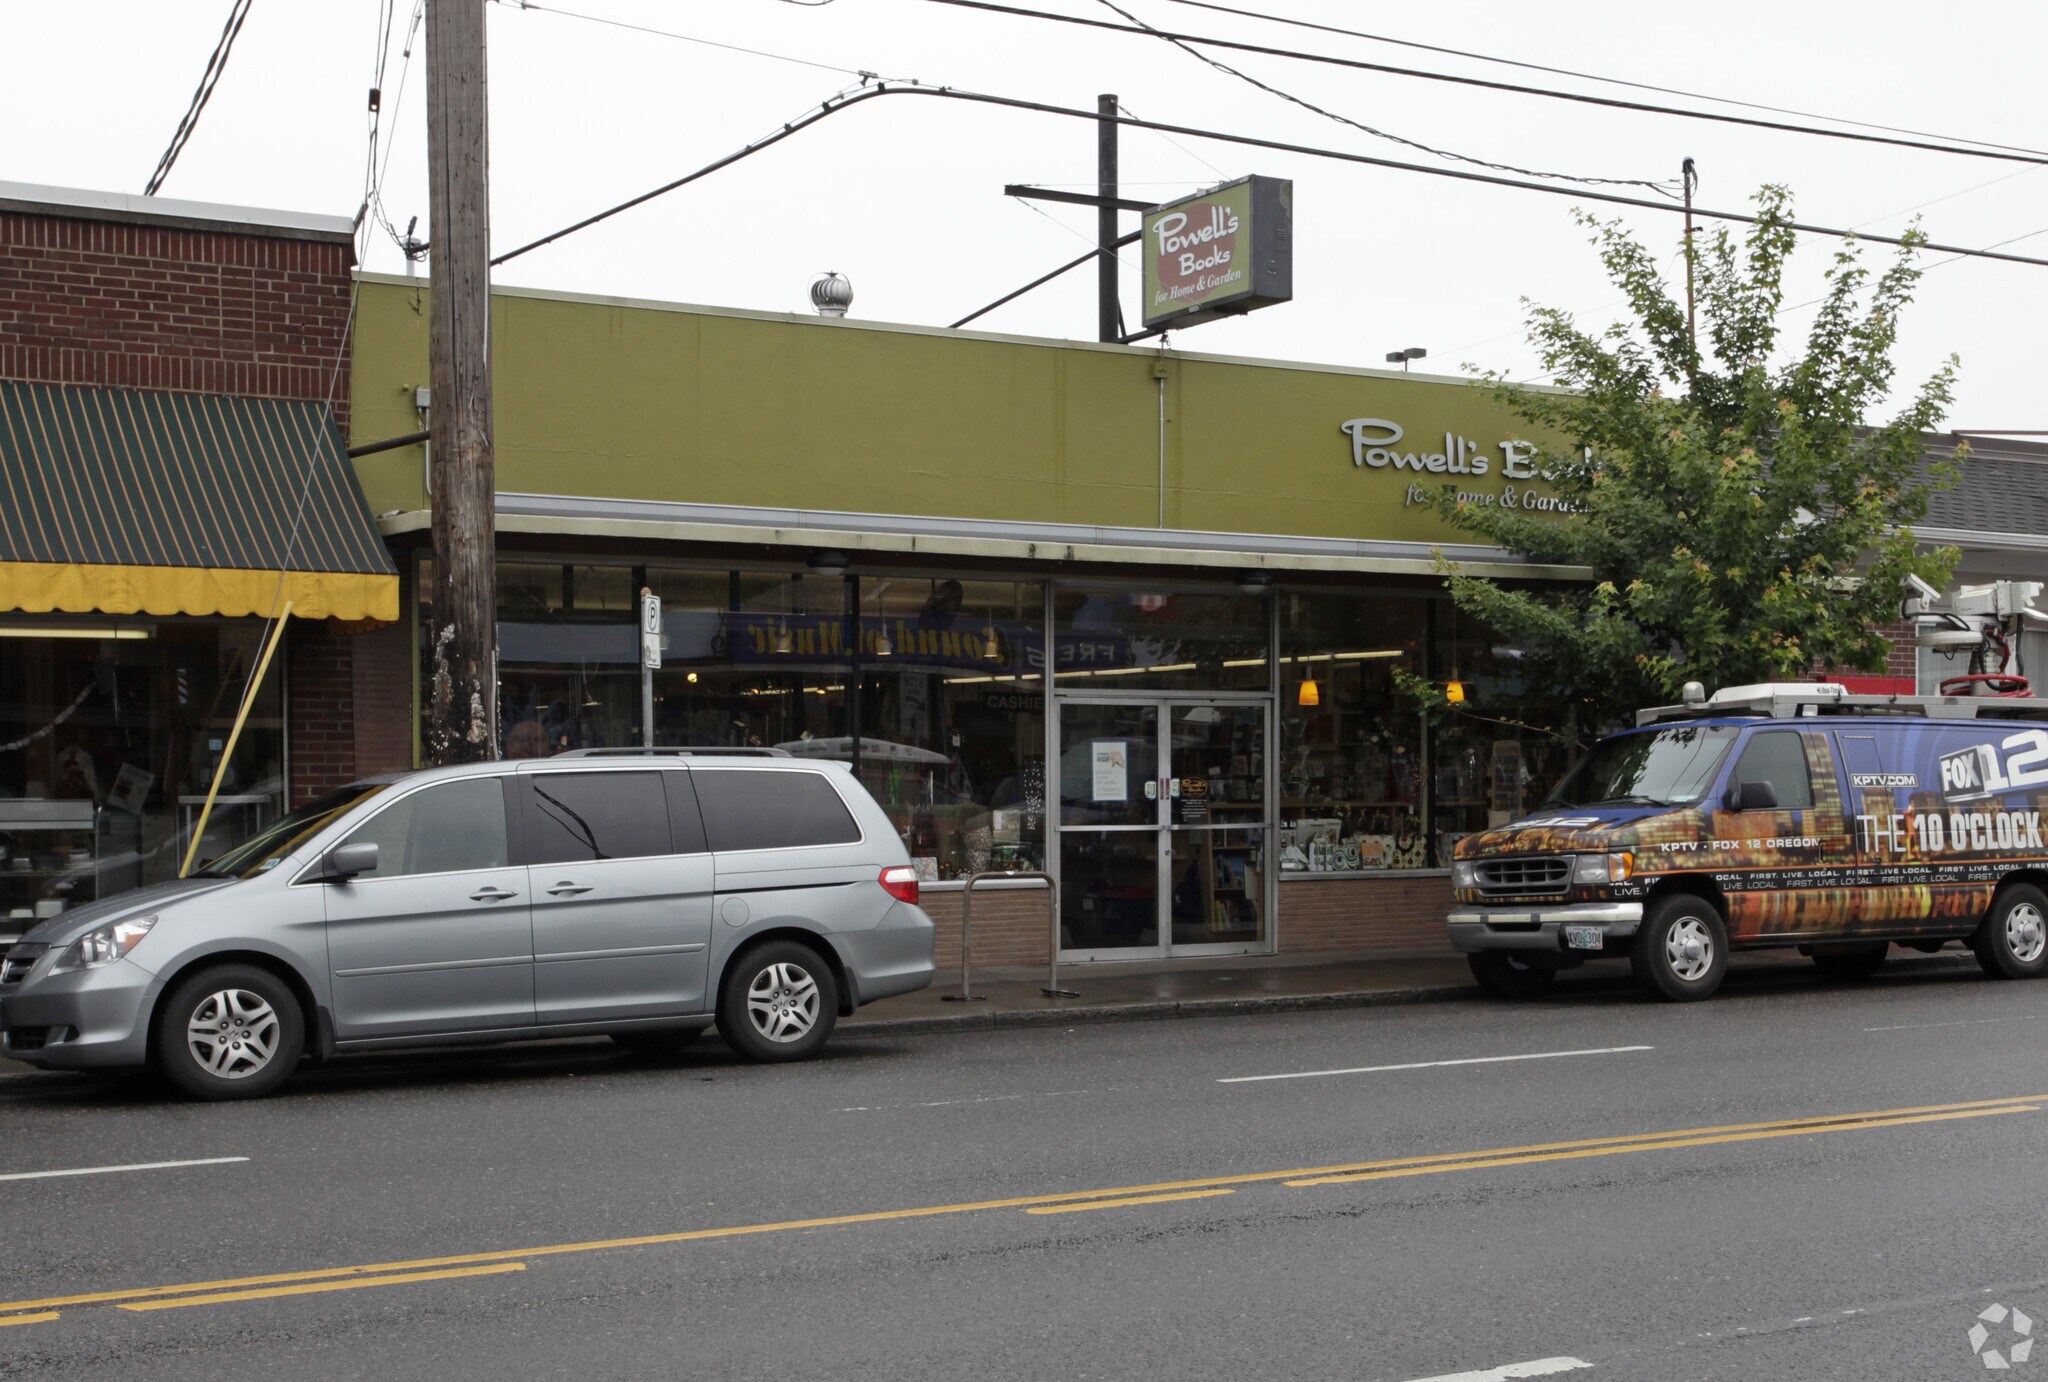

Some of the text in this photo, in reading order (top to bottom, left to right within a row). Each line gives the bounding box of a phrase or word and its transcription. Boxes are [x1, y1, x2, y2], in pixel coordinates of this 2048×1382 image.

[1152, 206, 1239, 256] Powell's
[1178, 245, 1231, 276] Books
[1155, 269, 1241, 306] for Home & Garden
[1341, 418, 1488, 475] Powell's
[1500, 485, 1518, 508] &
[987, 695, 1046, 710] CASHIE
[1940, 729, 2048, 792] FOX 12
[1853, 775, 1916, 786] KPTV.COM
[1661, 838, 1821, 852] KPTV FOX 12 OREGON
[1856, 811, 2043, 853] THE 10 O'CLOCK
